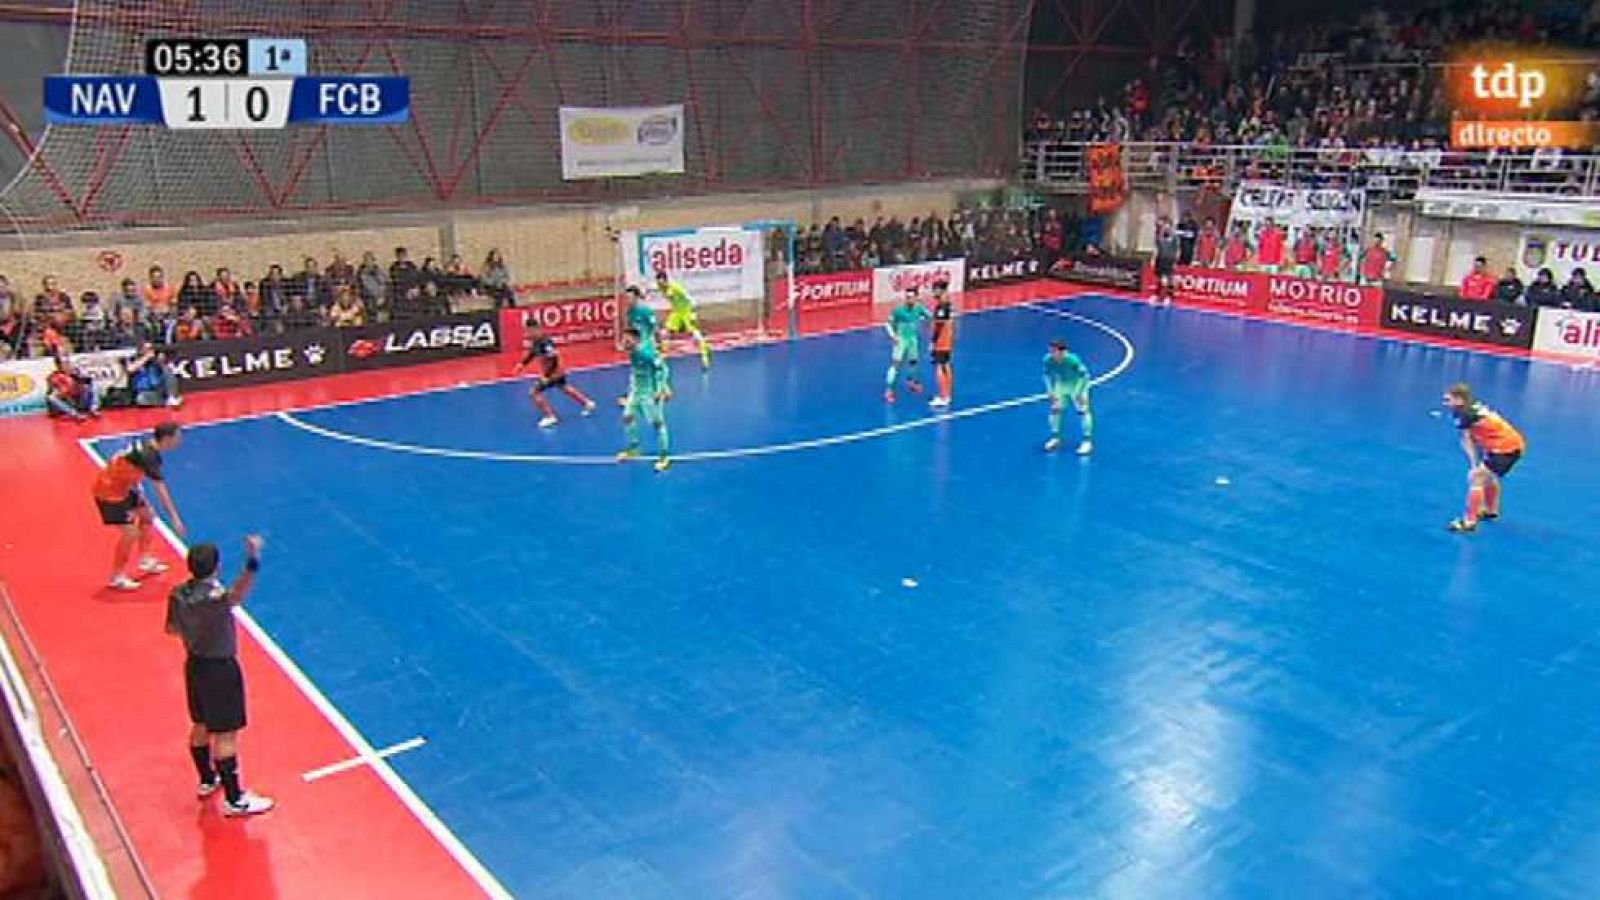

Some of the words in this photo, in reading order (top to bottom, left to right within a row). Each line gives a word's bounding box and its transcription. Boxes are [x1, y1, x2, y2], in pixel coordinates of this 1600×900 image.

[652, 236, 744, 272] aliseda
[1171, 274, 1249, 298] PORTIUM
[1270, 277, 1361, 307] MOTRIO
[1390, 303, 1492, 332] KELME
[169, 347, 295, 379] KELME
